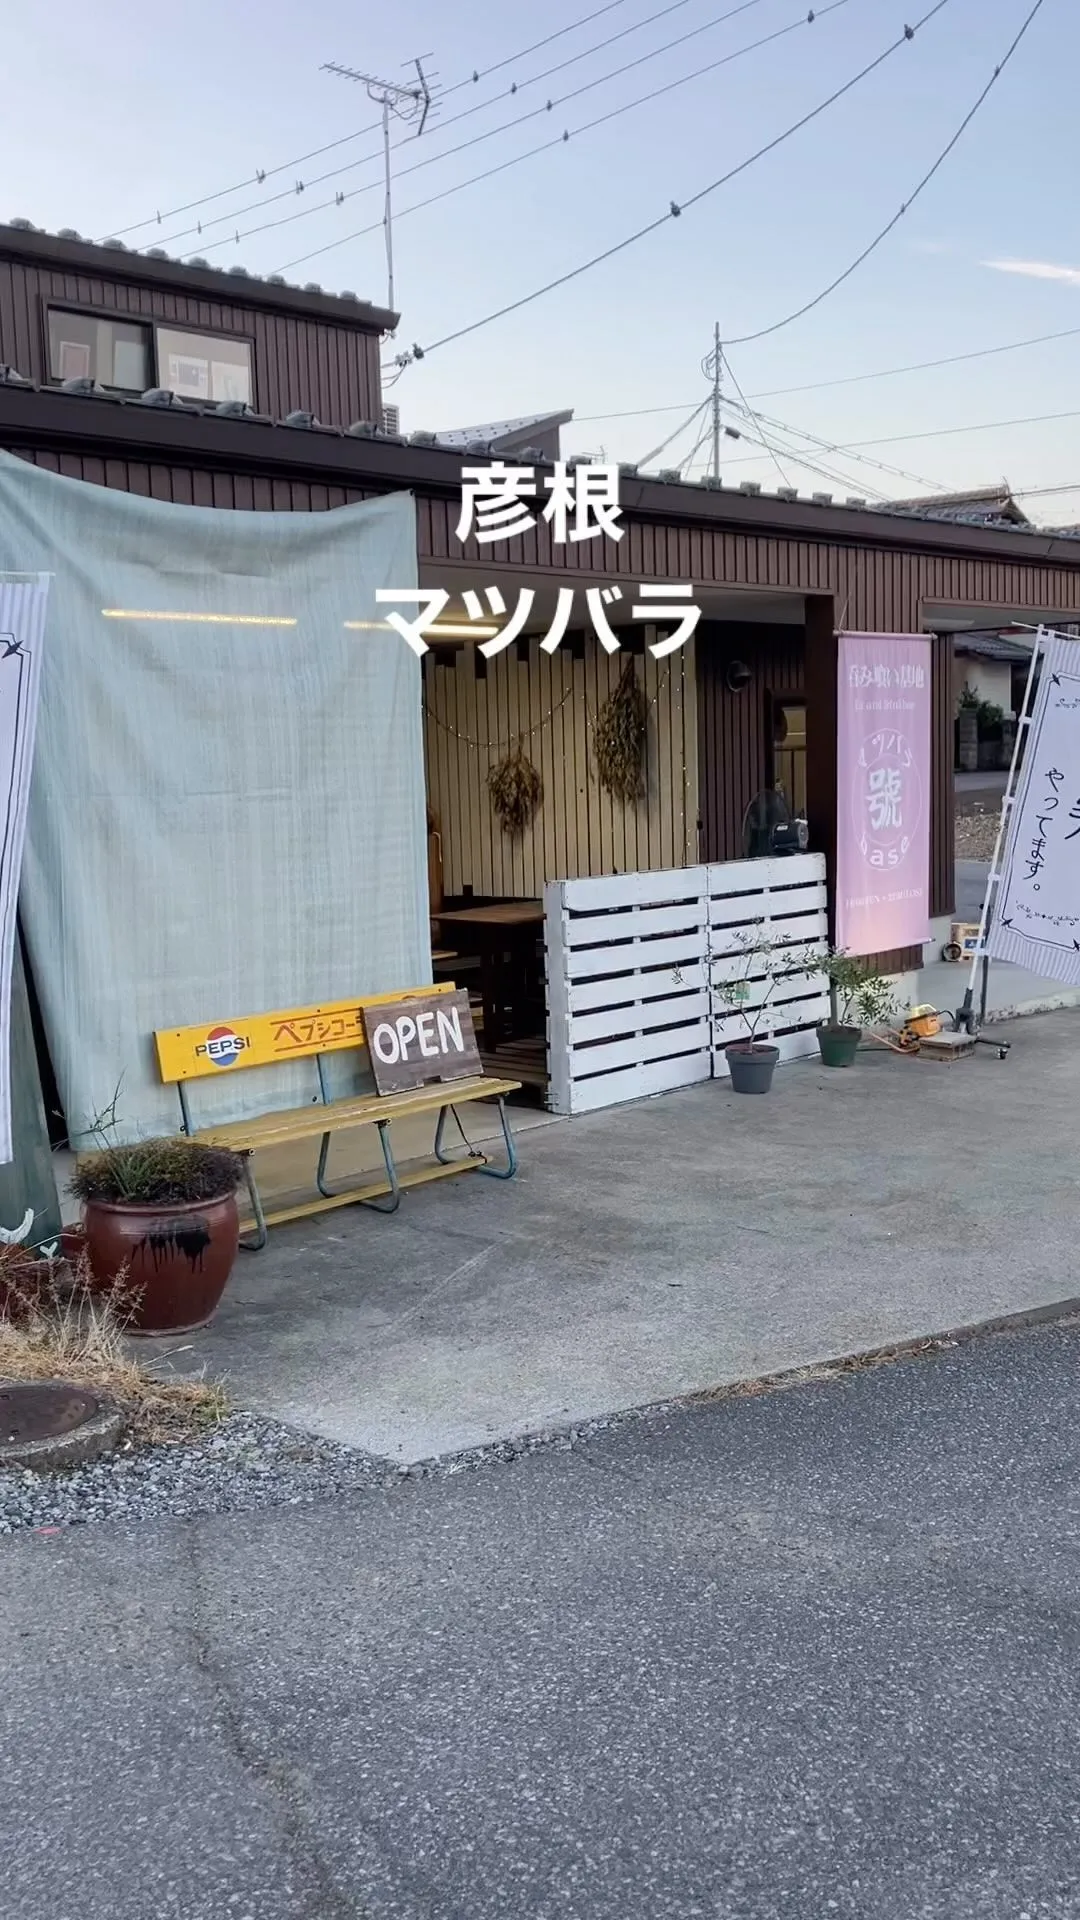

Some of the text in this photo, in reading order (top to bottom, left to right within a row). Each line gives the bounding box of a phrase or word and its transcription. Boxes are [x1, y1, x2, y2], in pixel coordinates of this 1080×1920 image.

[860, 832, 911, 866] base
[1022, 768, 1065, 891] やってます。
[195, 1036, 250, 1057] PEPSI
[373, 1006, 465, 1064] OPEN
